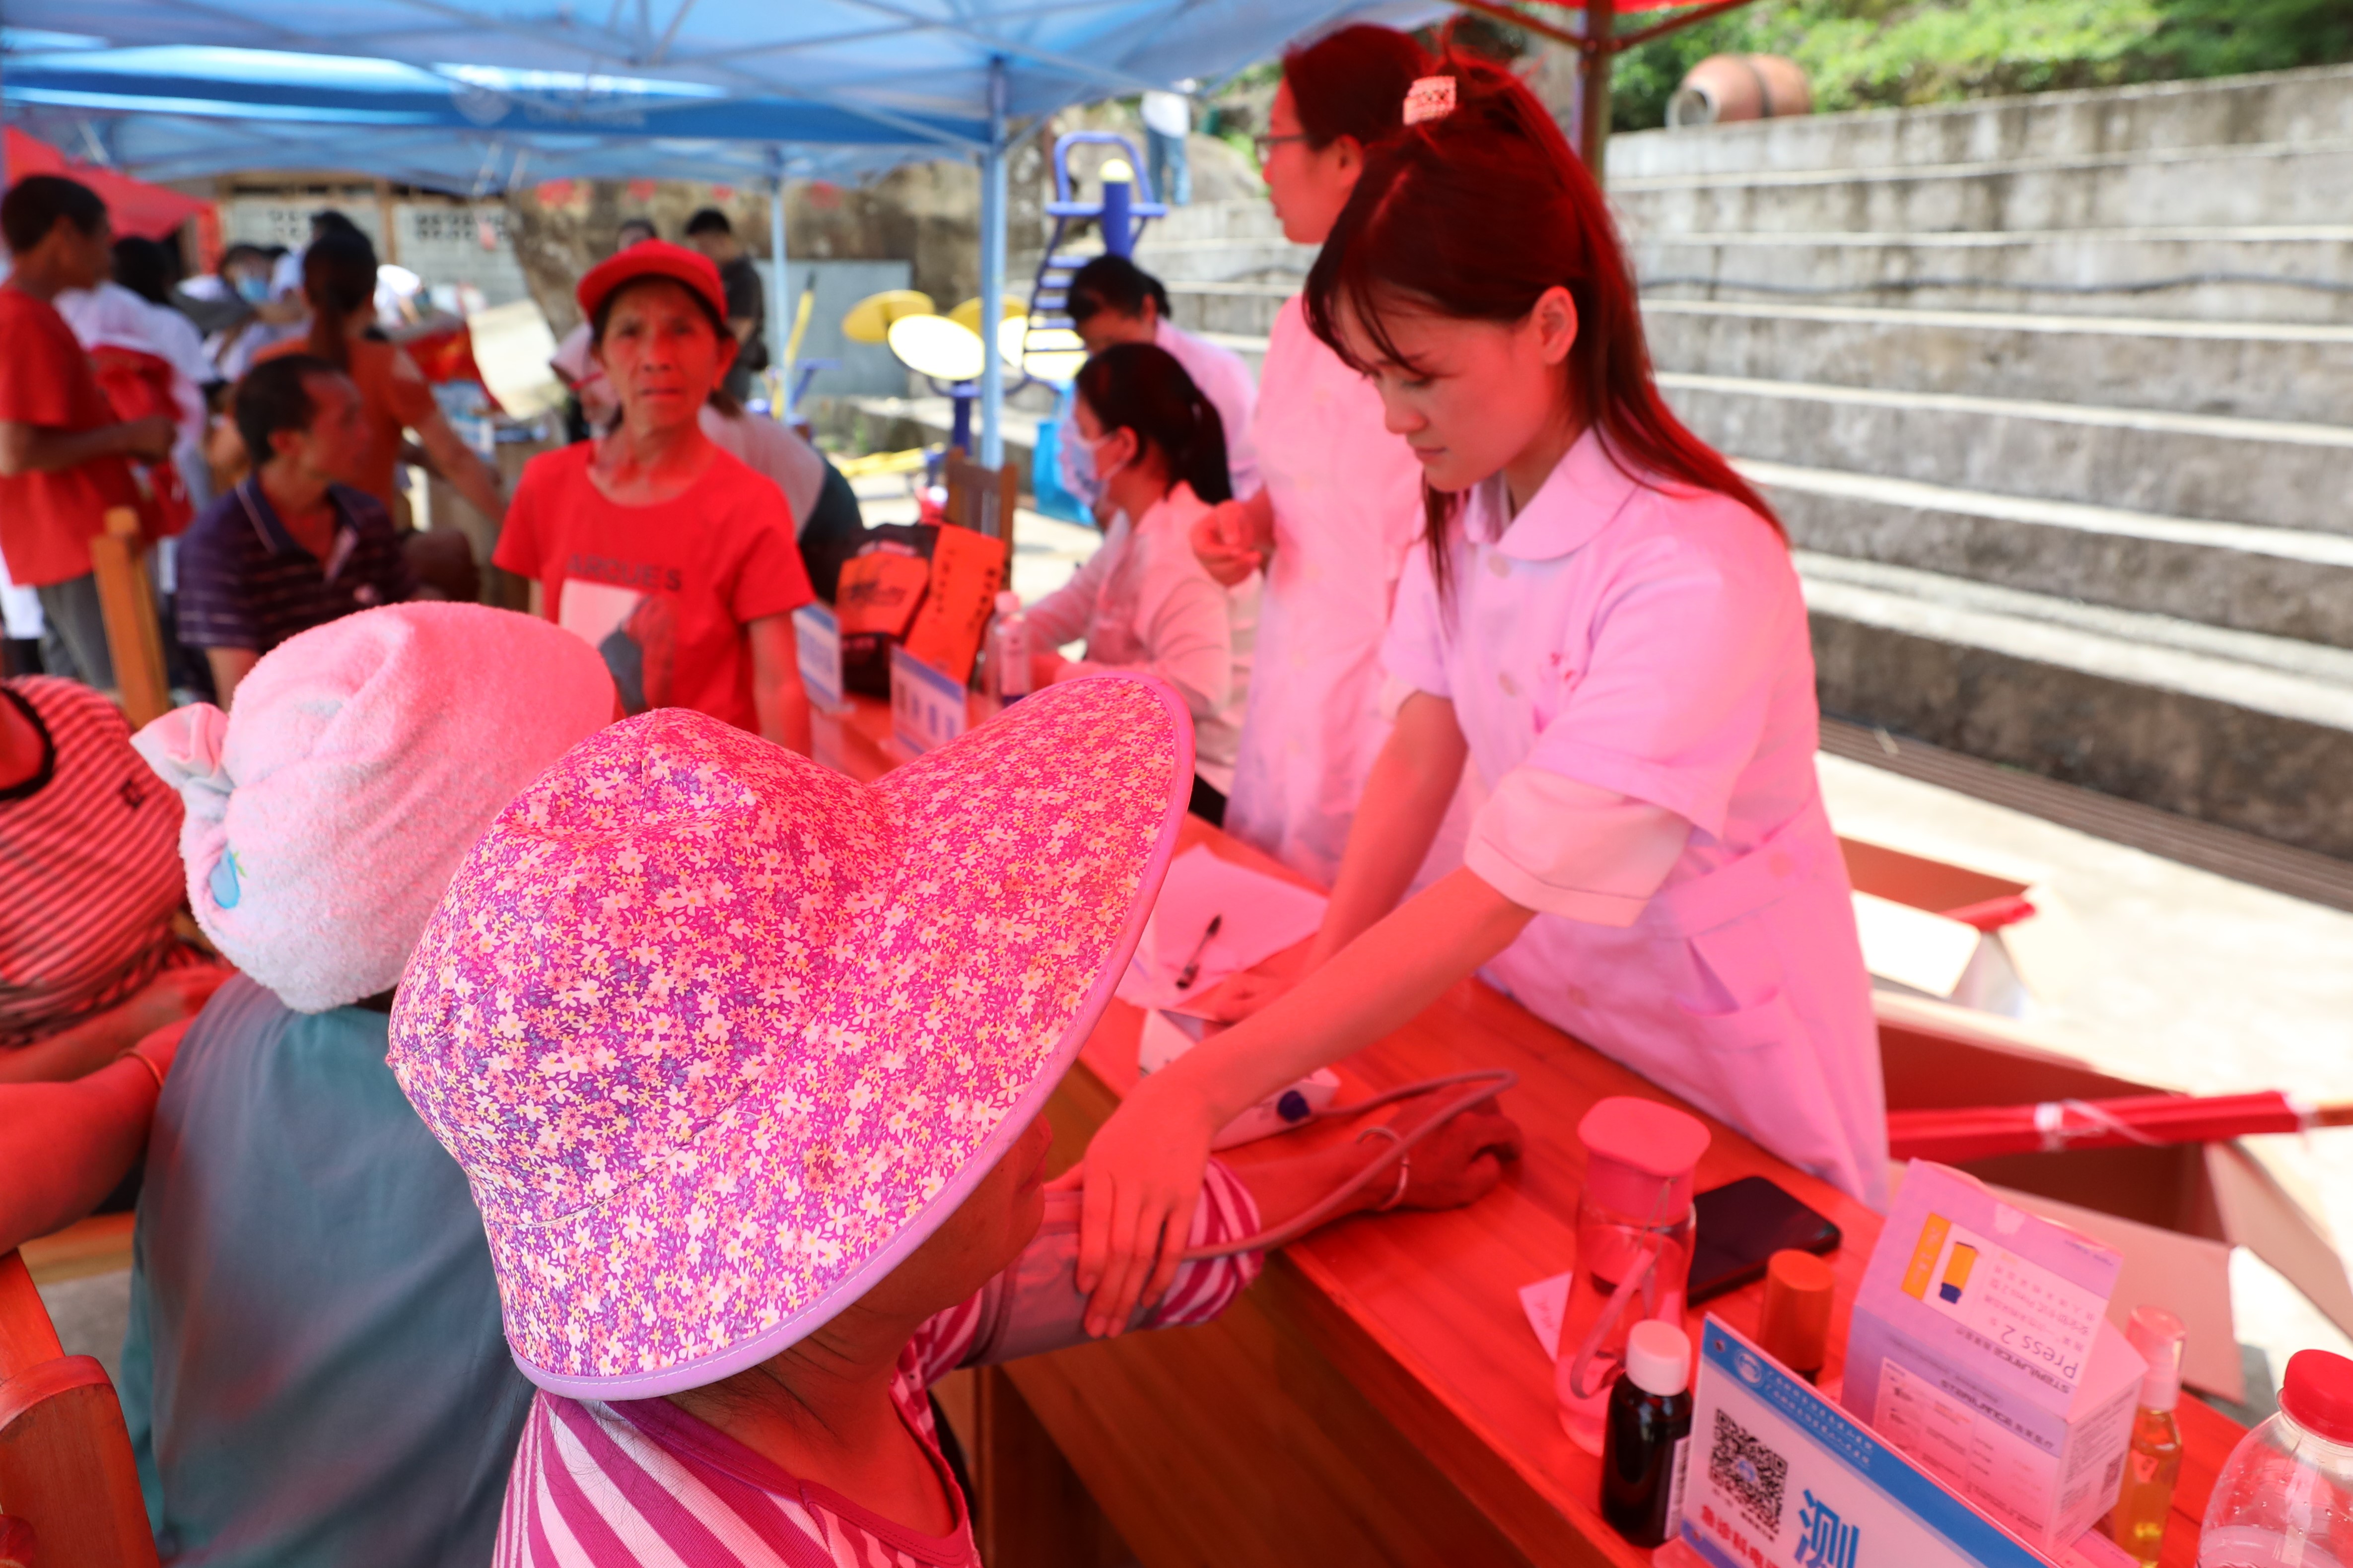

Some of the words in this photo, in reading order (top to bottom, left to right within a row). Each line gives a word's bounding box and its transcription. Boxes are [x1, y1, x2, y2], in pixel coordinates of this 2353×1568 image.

[2001, 1324, 2016, 1344] 2
[2022, 1335, 2078, 1379] Press
[1795, 1489, 1860, 1568] 测
